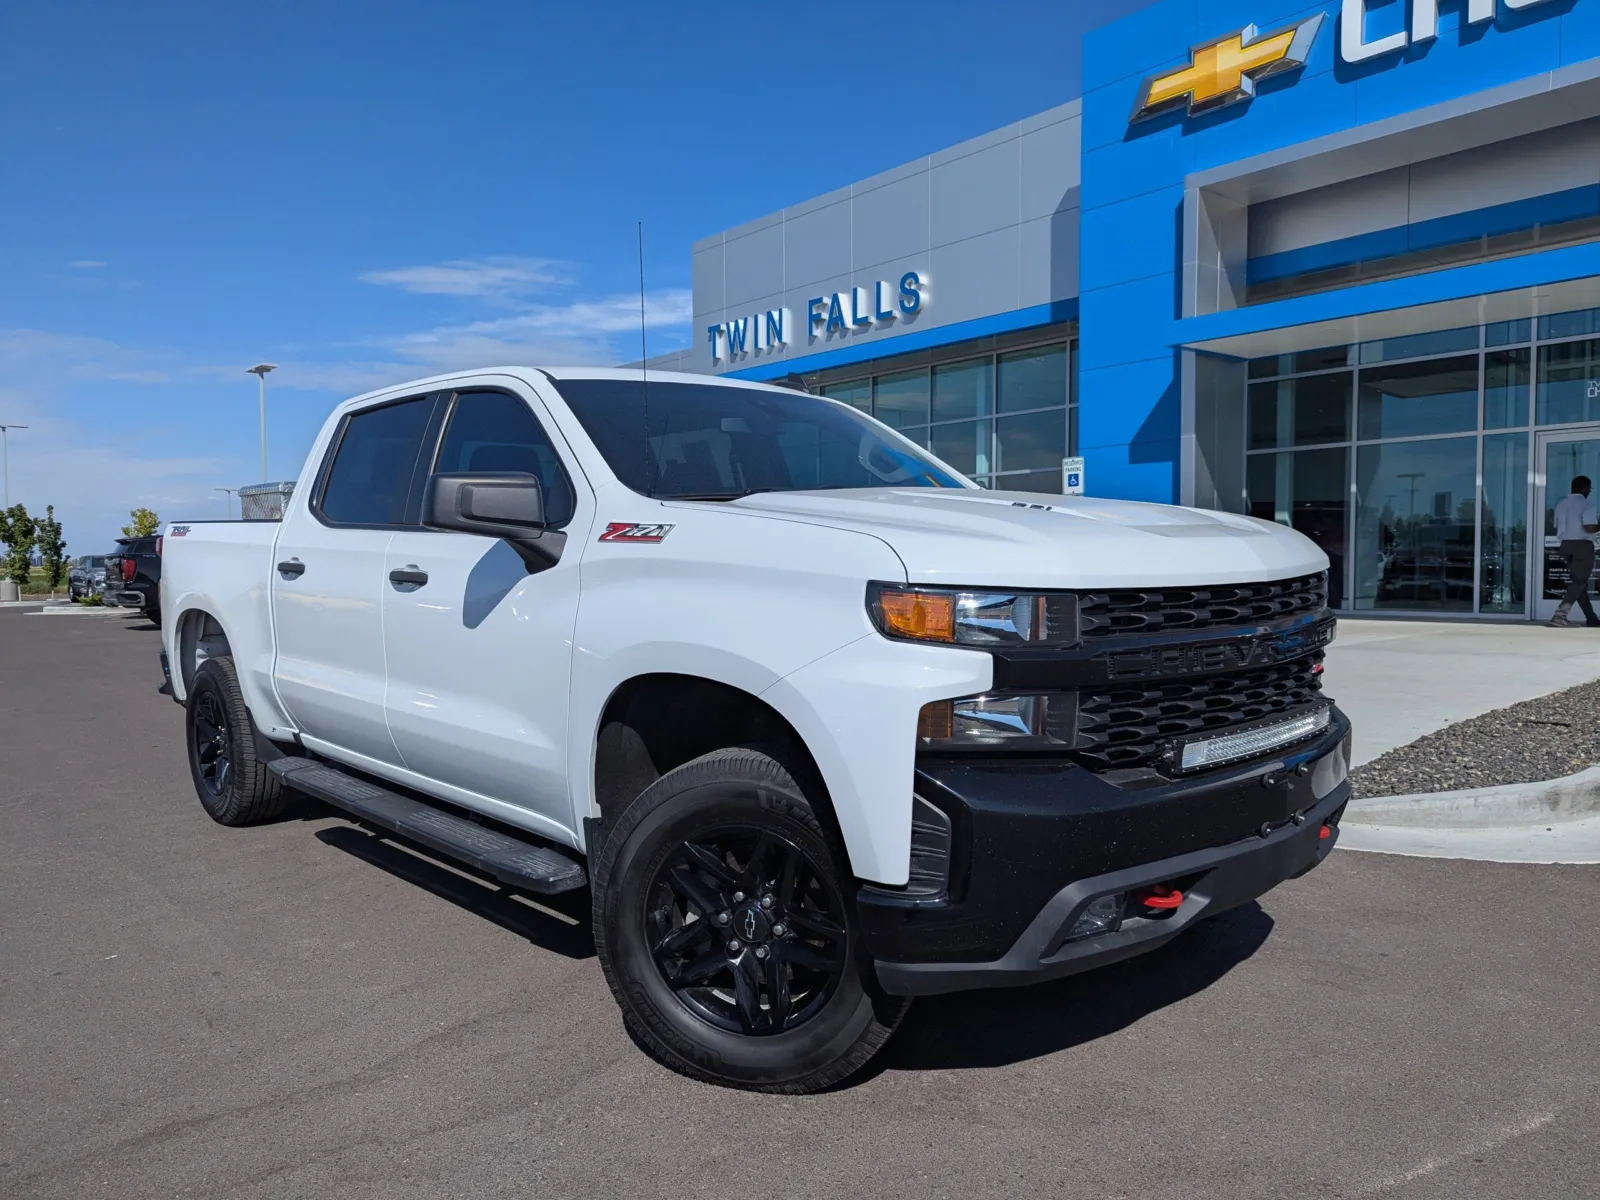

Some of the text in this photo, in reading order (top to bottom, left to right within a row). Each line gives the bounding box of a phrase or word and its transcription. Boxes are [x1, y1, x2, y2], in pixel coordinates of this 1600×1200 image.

[708, 271, 927, 359] TWIN FALLS
[598, 522, 676, 544] Z71
